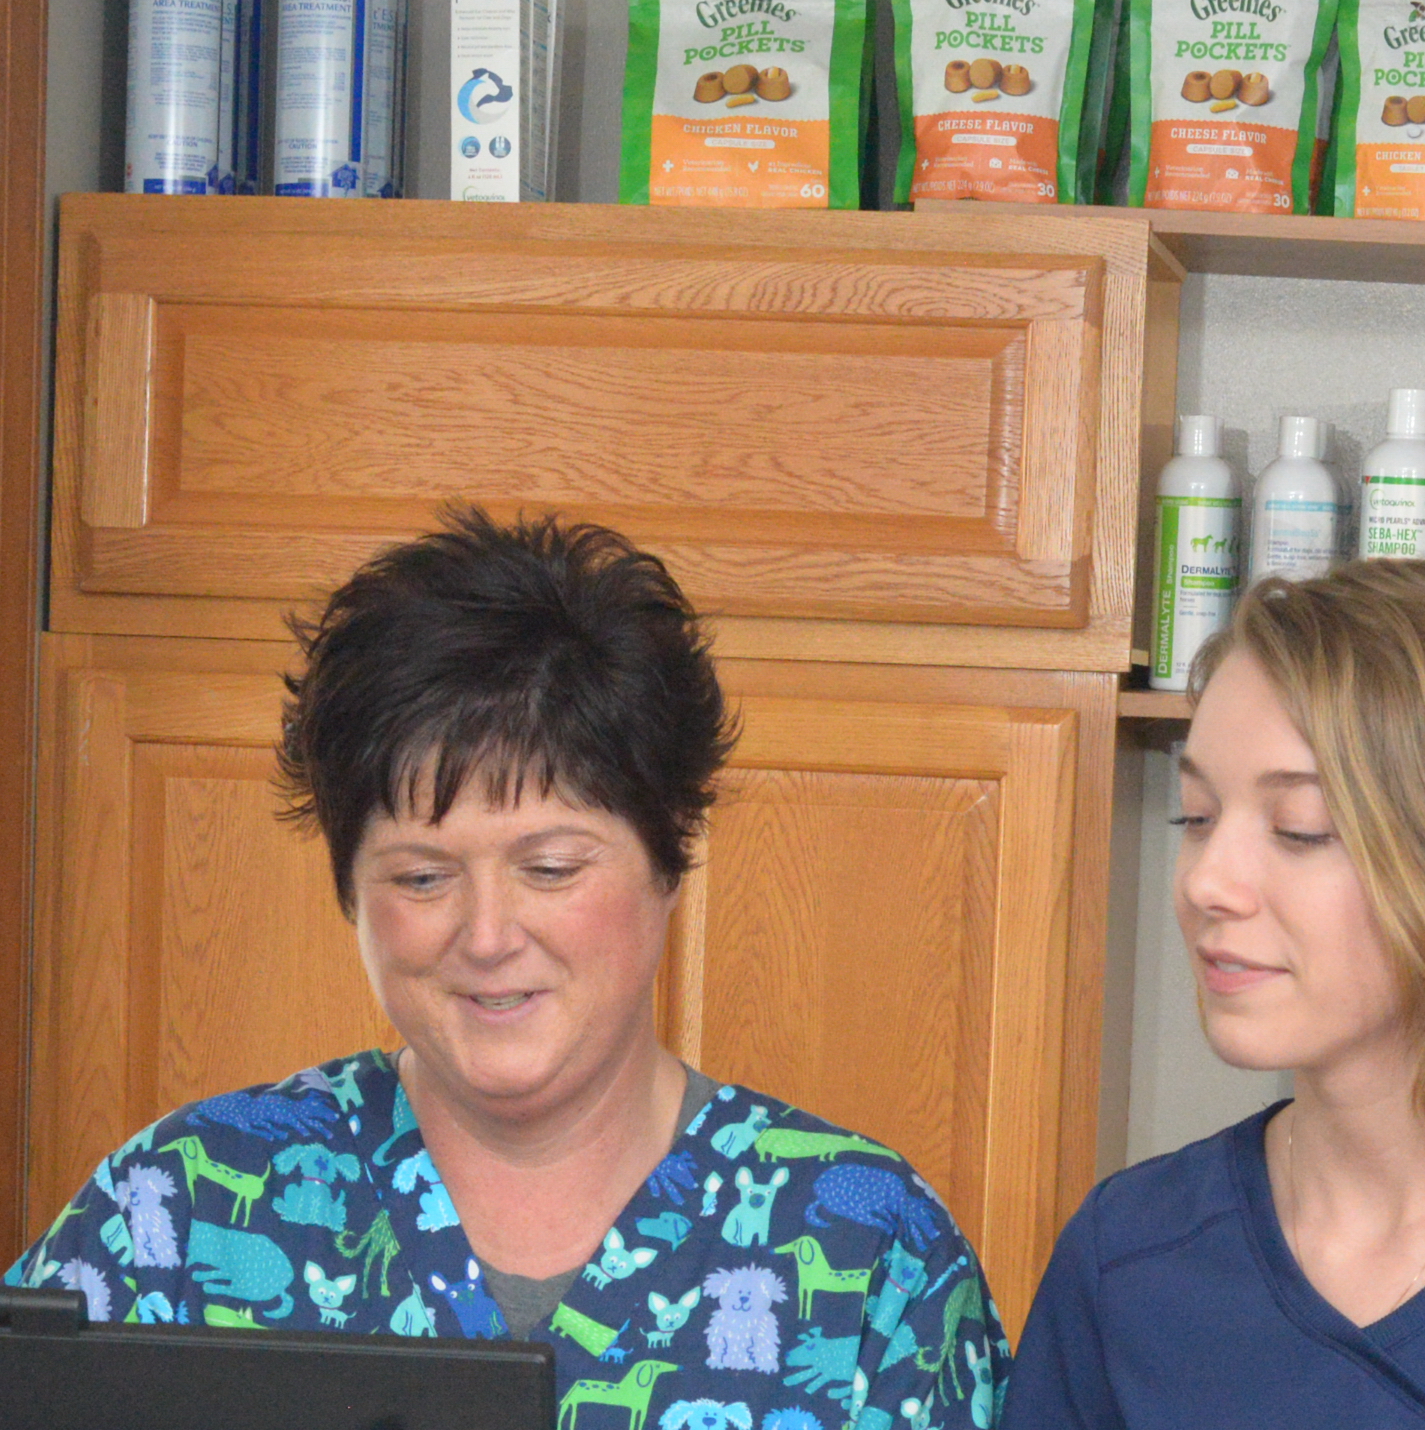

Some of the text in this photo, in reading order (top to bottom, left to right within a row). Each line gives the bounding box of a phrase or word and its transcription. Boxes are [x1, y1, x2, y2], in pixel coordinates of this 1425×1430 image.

[965, 10, 1016, 33] PILL
[1209, 21, 1261, 40] PILL
[719, 20, 775, 42] PILL
[934, 29, 1046, 54] POCKETS
[682, 37, 806, 66] POCKETS
[1174, 40, 1288, 62] POCKETS
[682, 123, 799, 138] CHICKEN FLAVOR
[937, 119, 1035, 134] CHEESE FLAVOR
[1170, 127, 1268, 145] CHEESE FLAVOR
[1375, 150, 1421, 162] CHICKEN
[799, 183, 826, 199] 60
[1037, 182, 1056, 198] 30
[1273, 192, 1291, 209] 30
[1367, 540, 1417, 556] SHAMPOO
[1158, 544, 1175, 675] DERMALYTE Shampoo
